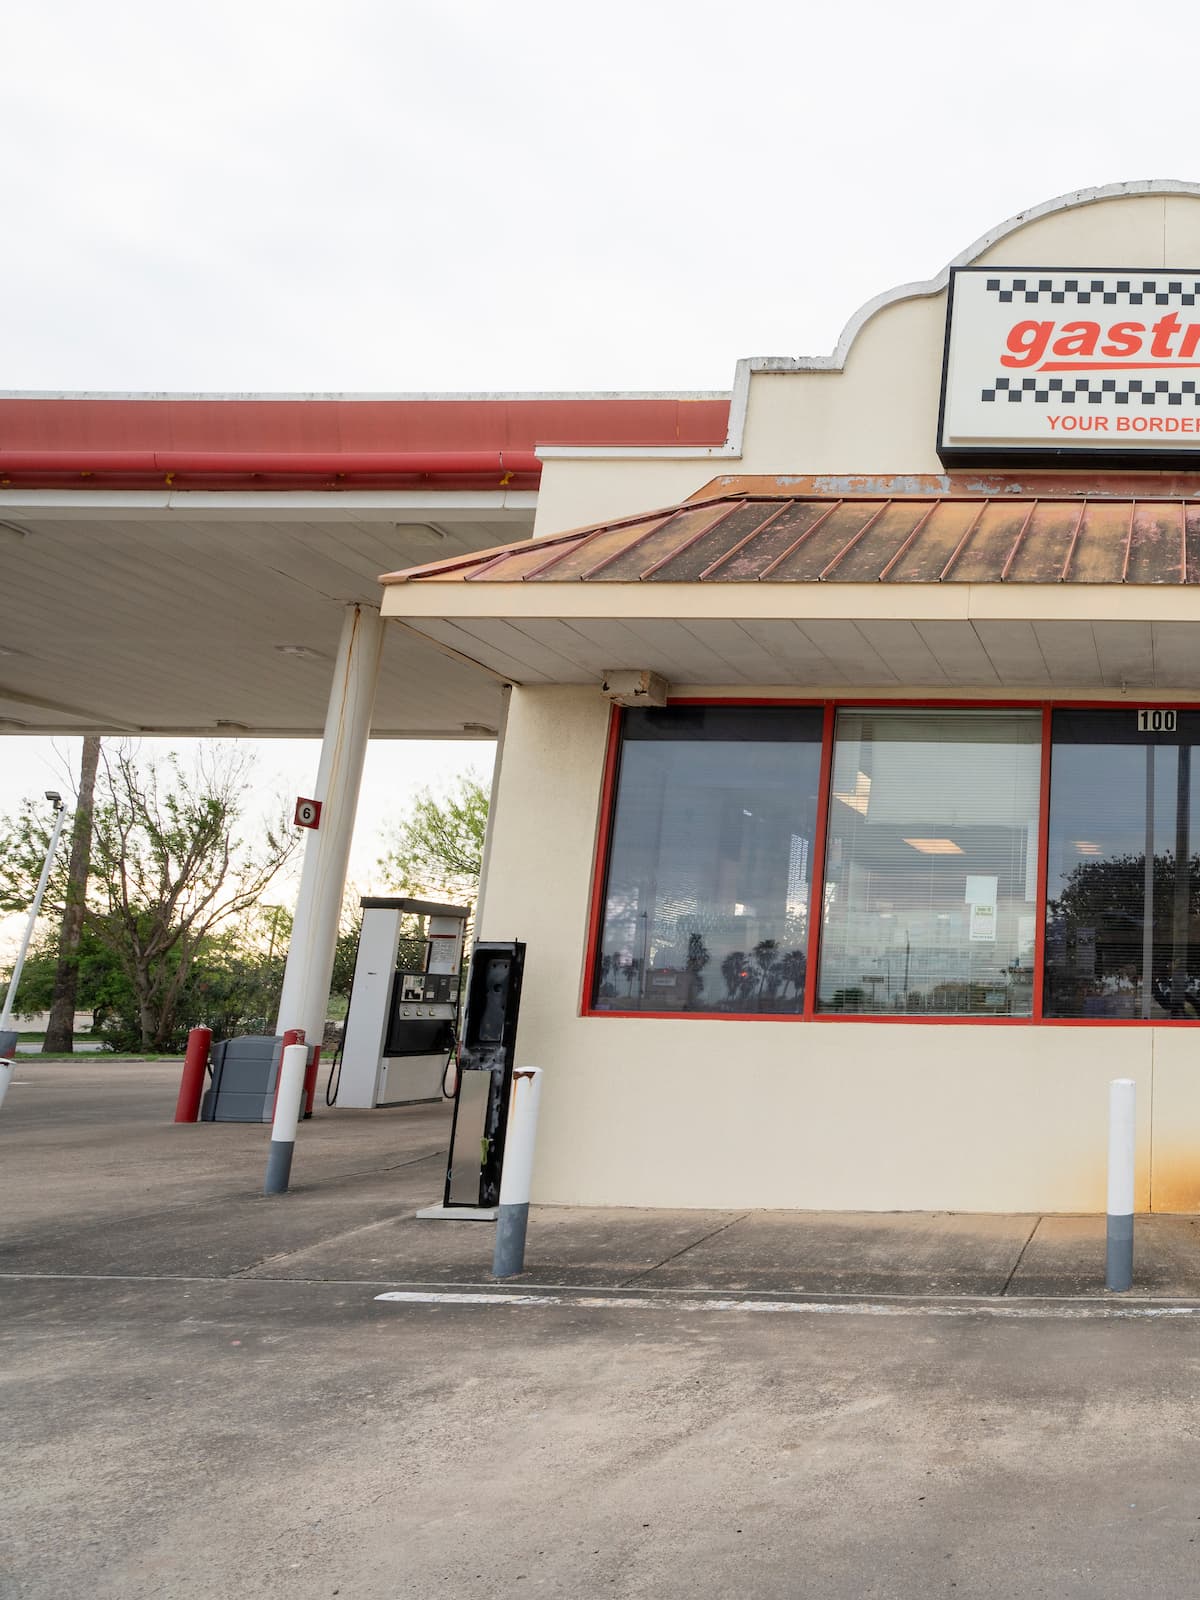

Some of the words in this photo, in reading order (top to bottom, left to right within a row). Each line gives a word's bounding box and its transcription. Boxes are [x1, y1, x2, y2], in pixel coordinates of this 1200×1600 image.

[1046, 415, 1109, 431] YOUR
[1140, 710, 1175, 730] 100
[303, 807, 311, 819] 6
